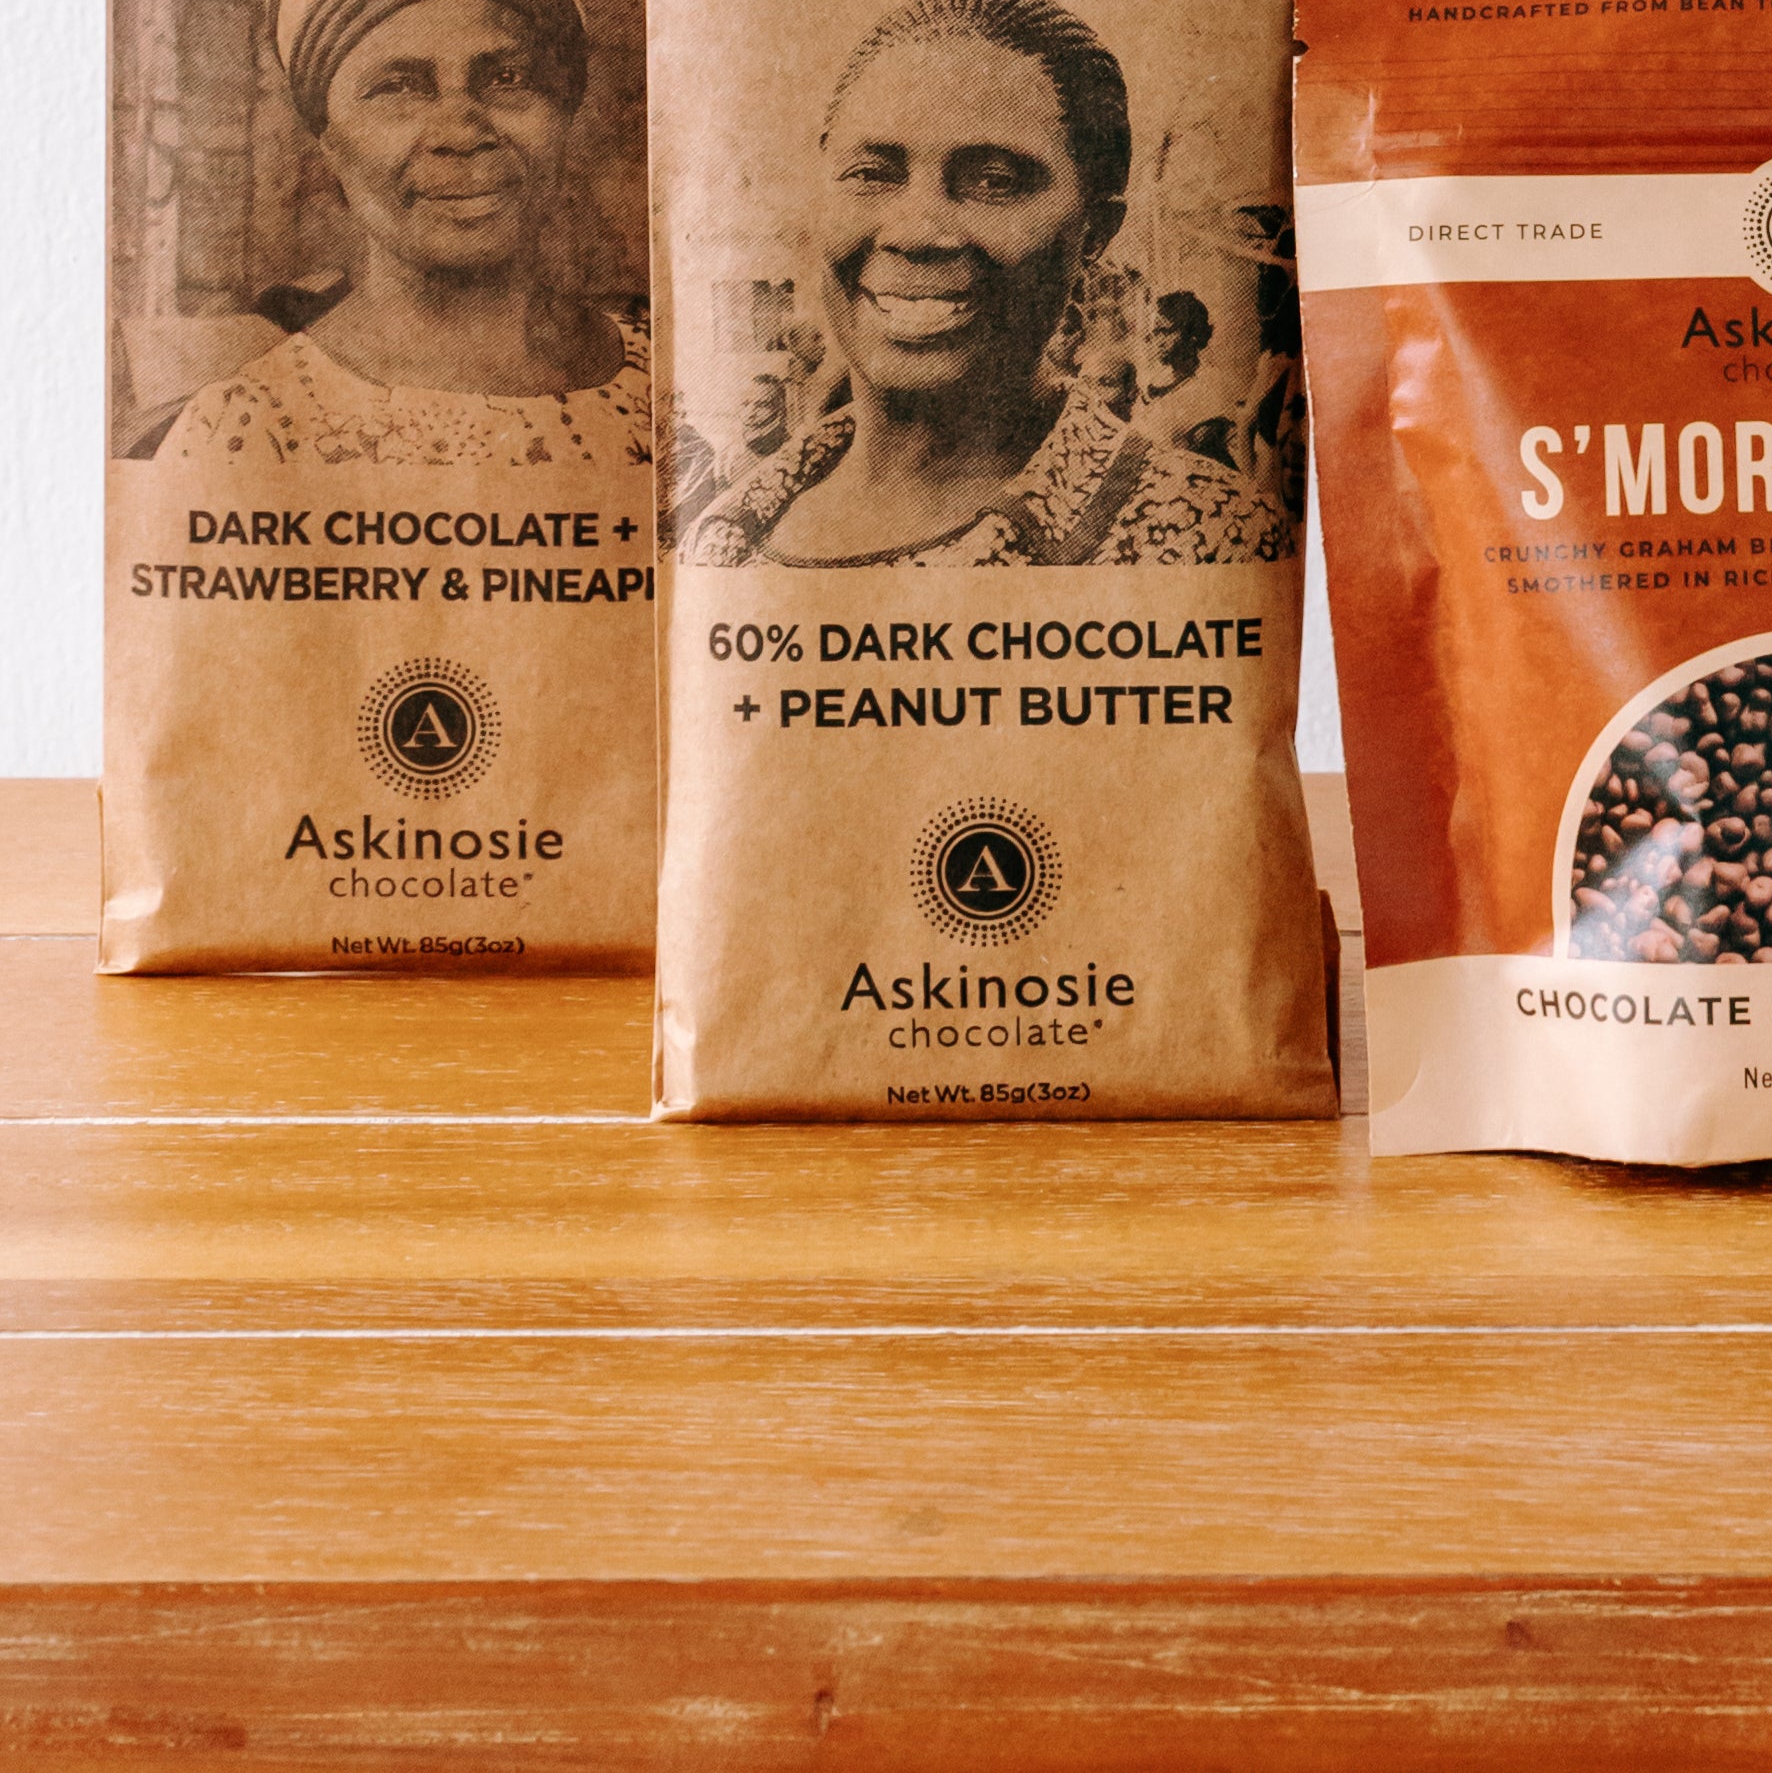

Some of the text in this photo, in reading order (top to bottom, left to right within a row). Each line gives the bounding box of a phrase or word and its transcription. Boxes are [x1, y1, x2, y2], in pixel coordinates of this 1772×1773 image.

[1408, 2, 1590, 22] HANDCRAFTED
[1409, 223, 1603, 242] DIRECT TRADE
[188, 510, 638, 547] DARK CHOCOLATE +
[1484, 543, 1606, 563] CRUNCHY
[1619, 538, 1736, 558] GRAHAM
[131, 563, 429, 602] STRAWBERRY
[442, 568, 469, 601] &
[1507, 571, 1671, 594] SMOTHERED
[1683, 571, 1710, 588] IN
[708, 618, 1263, 663] 60% DARK CHOCOLATE
[402, 703, 457, 748] A
[733, 685, 1233, 728] + PEANUT BUTTER
[285, 814, 564, 860] Askinosie
[957, 844, 1017, 892] A
[332, 936, 373, 955] Net
[419, 936, 525, 956] 85g(3oz)
[841, 962, 1136, 1011] Askinosie
[1516, 988, 1752, 1026] CHOCOLATE
[888, 1082, 1091, 1106] Net Wt. 85g(3oz)
